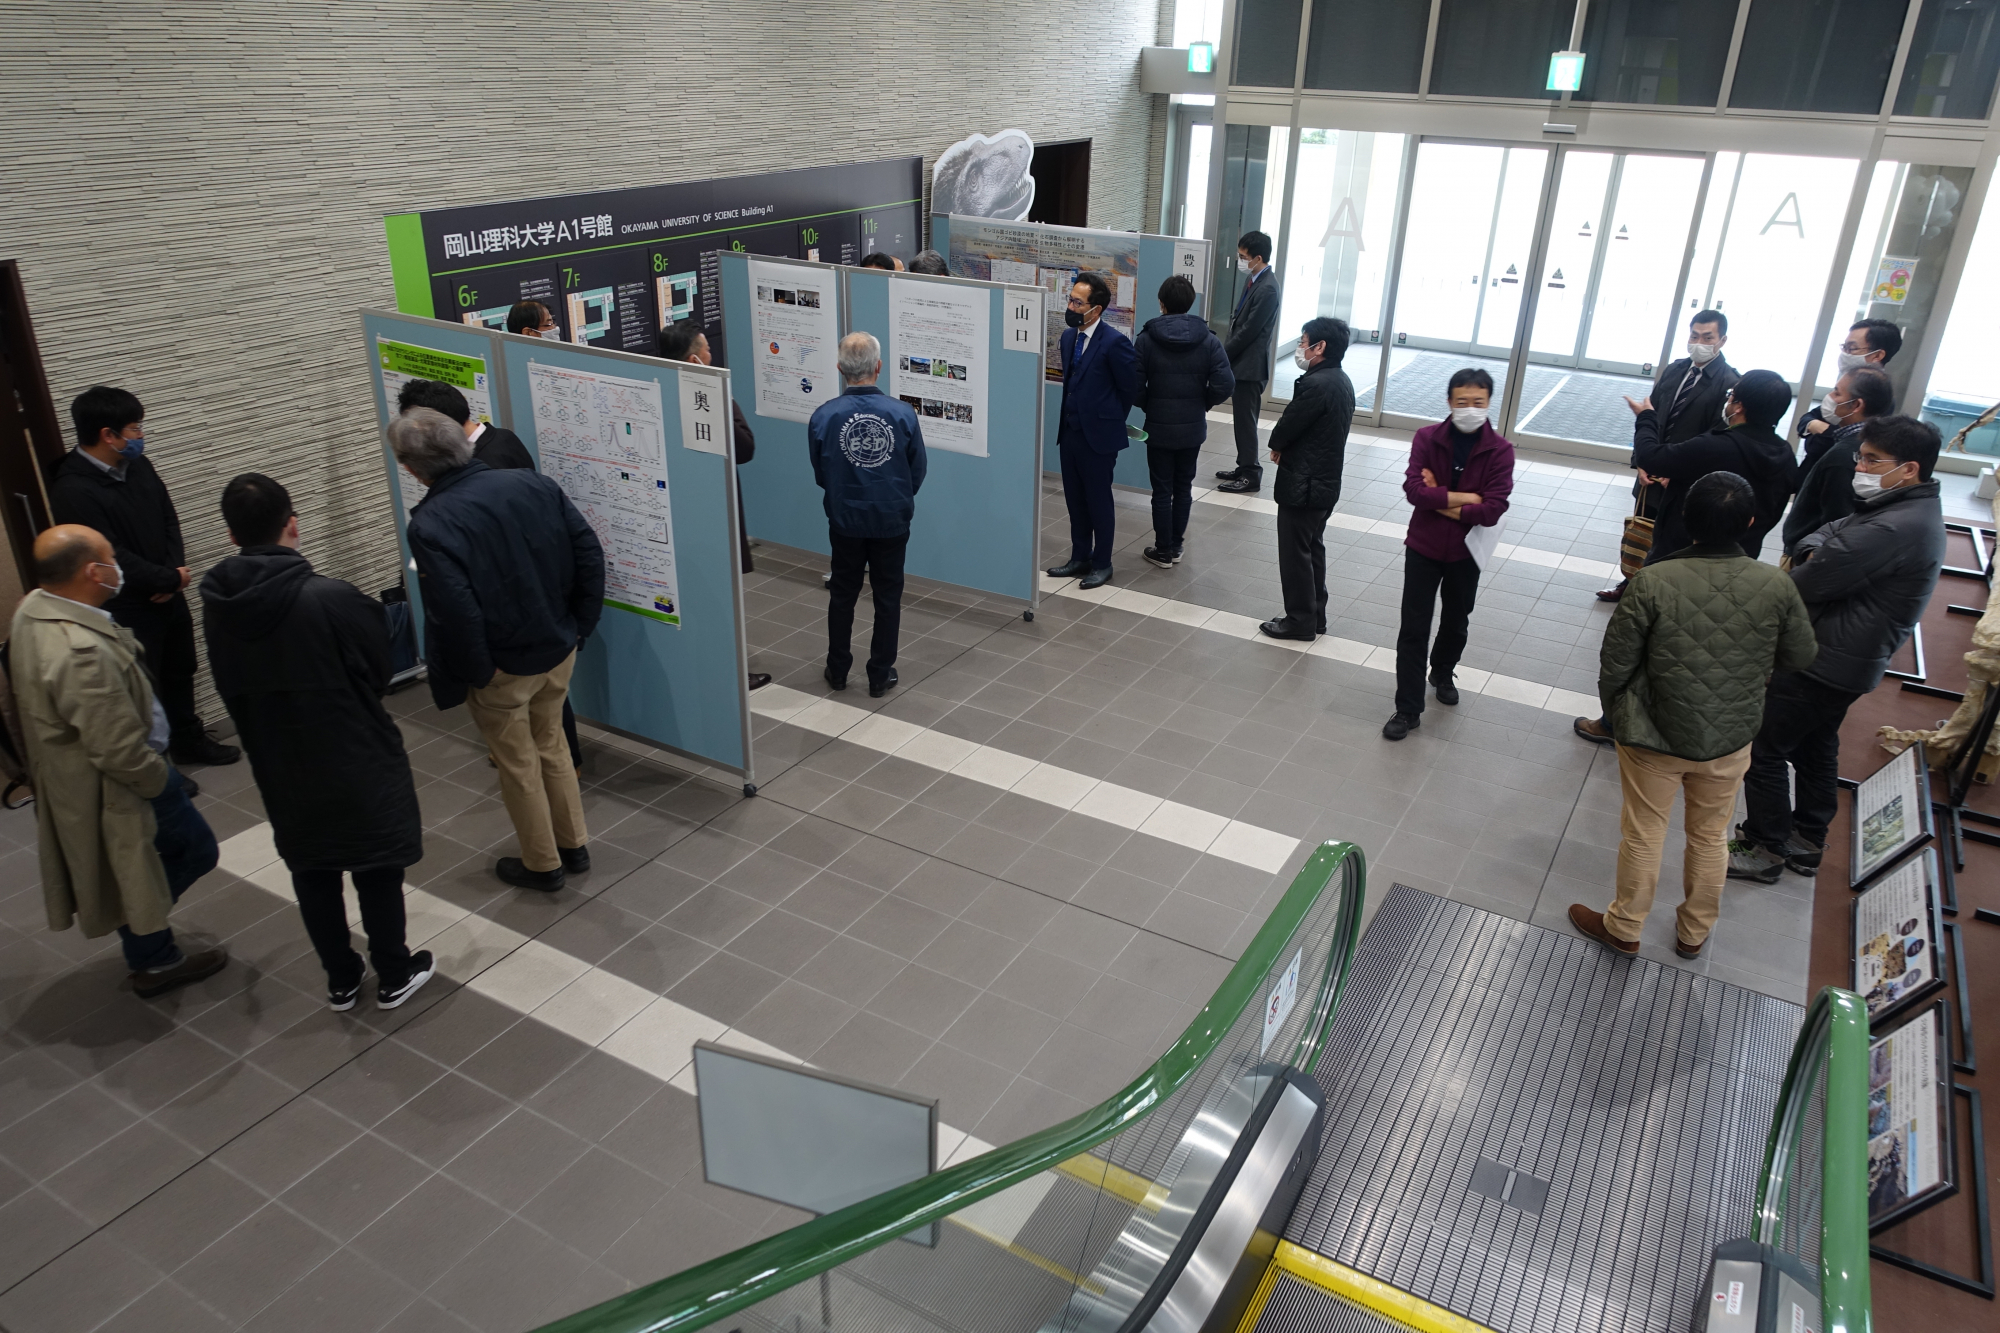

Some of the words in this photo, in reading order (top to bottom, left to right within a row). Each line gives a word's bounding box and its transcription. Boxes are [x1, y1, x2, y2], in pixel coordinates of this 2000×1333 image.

[863, 218, 878, 235] 11F
[1318, 197, 1366, 252] A
[1759, 192, 1805, 239] A
[443, 214, 613, 259] 岡山理科大学A1号館
[621, 221, 659, 234] OKAYAMA
[662, 215, 700, 228] UNIVERSITY
[702, 213, 712, 222] OF
[714, 209, 739, 221] SCIENCE
[741, 206, 766, 217] Building
[766, 204, 774, 213] A1
[802, 227, 819, 246] 10F
[653, 253, 669, 272] 8F
[562, 268, 581, 289] 7F
[458, 285, 479, 307] 6F
[1015, 304, 1029, 342] 山口
[693, 390, 711, 442] 奥田
[851, 437, 886, 452] ESD
